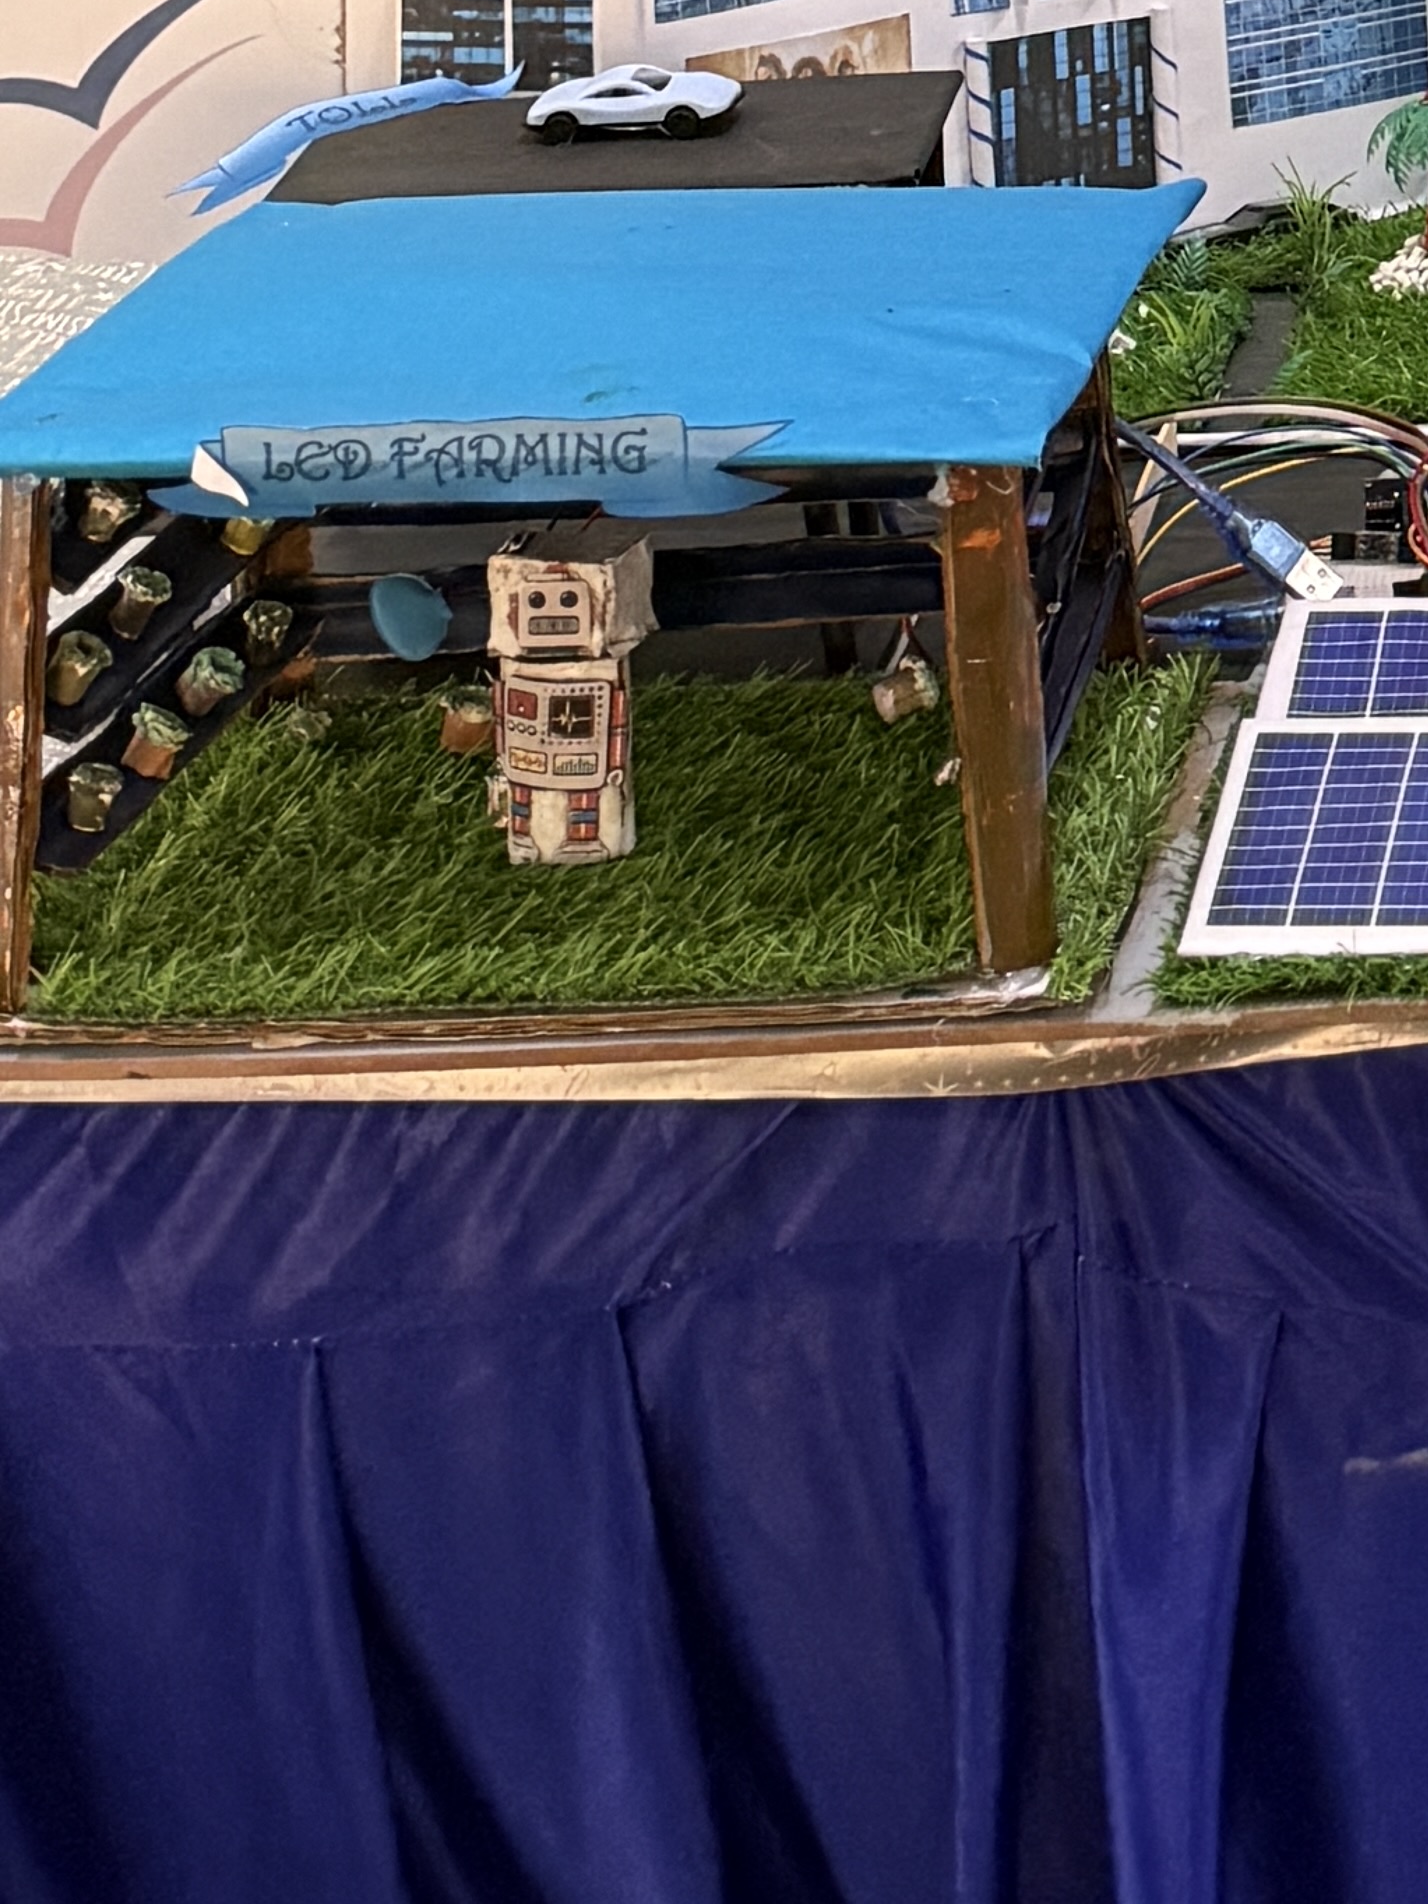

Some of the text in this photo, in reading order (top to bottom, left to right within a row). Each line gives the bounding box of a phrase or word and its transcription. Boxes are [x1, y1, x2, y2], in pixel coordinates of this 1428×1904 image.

[284, 94, 420, 135] TOLL
[261, 427, 649, 487] LED FARMING
